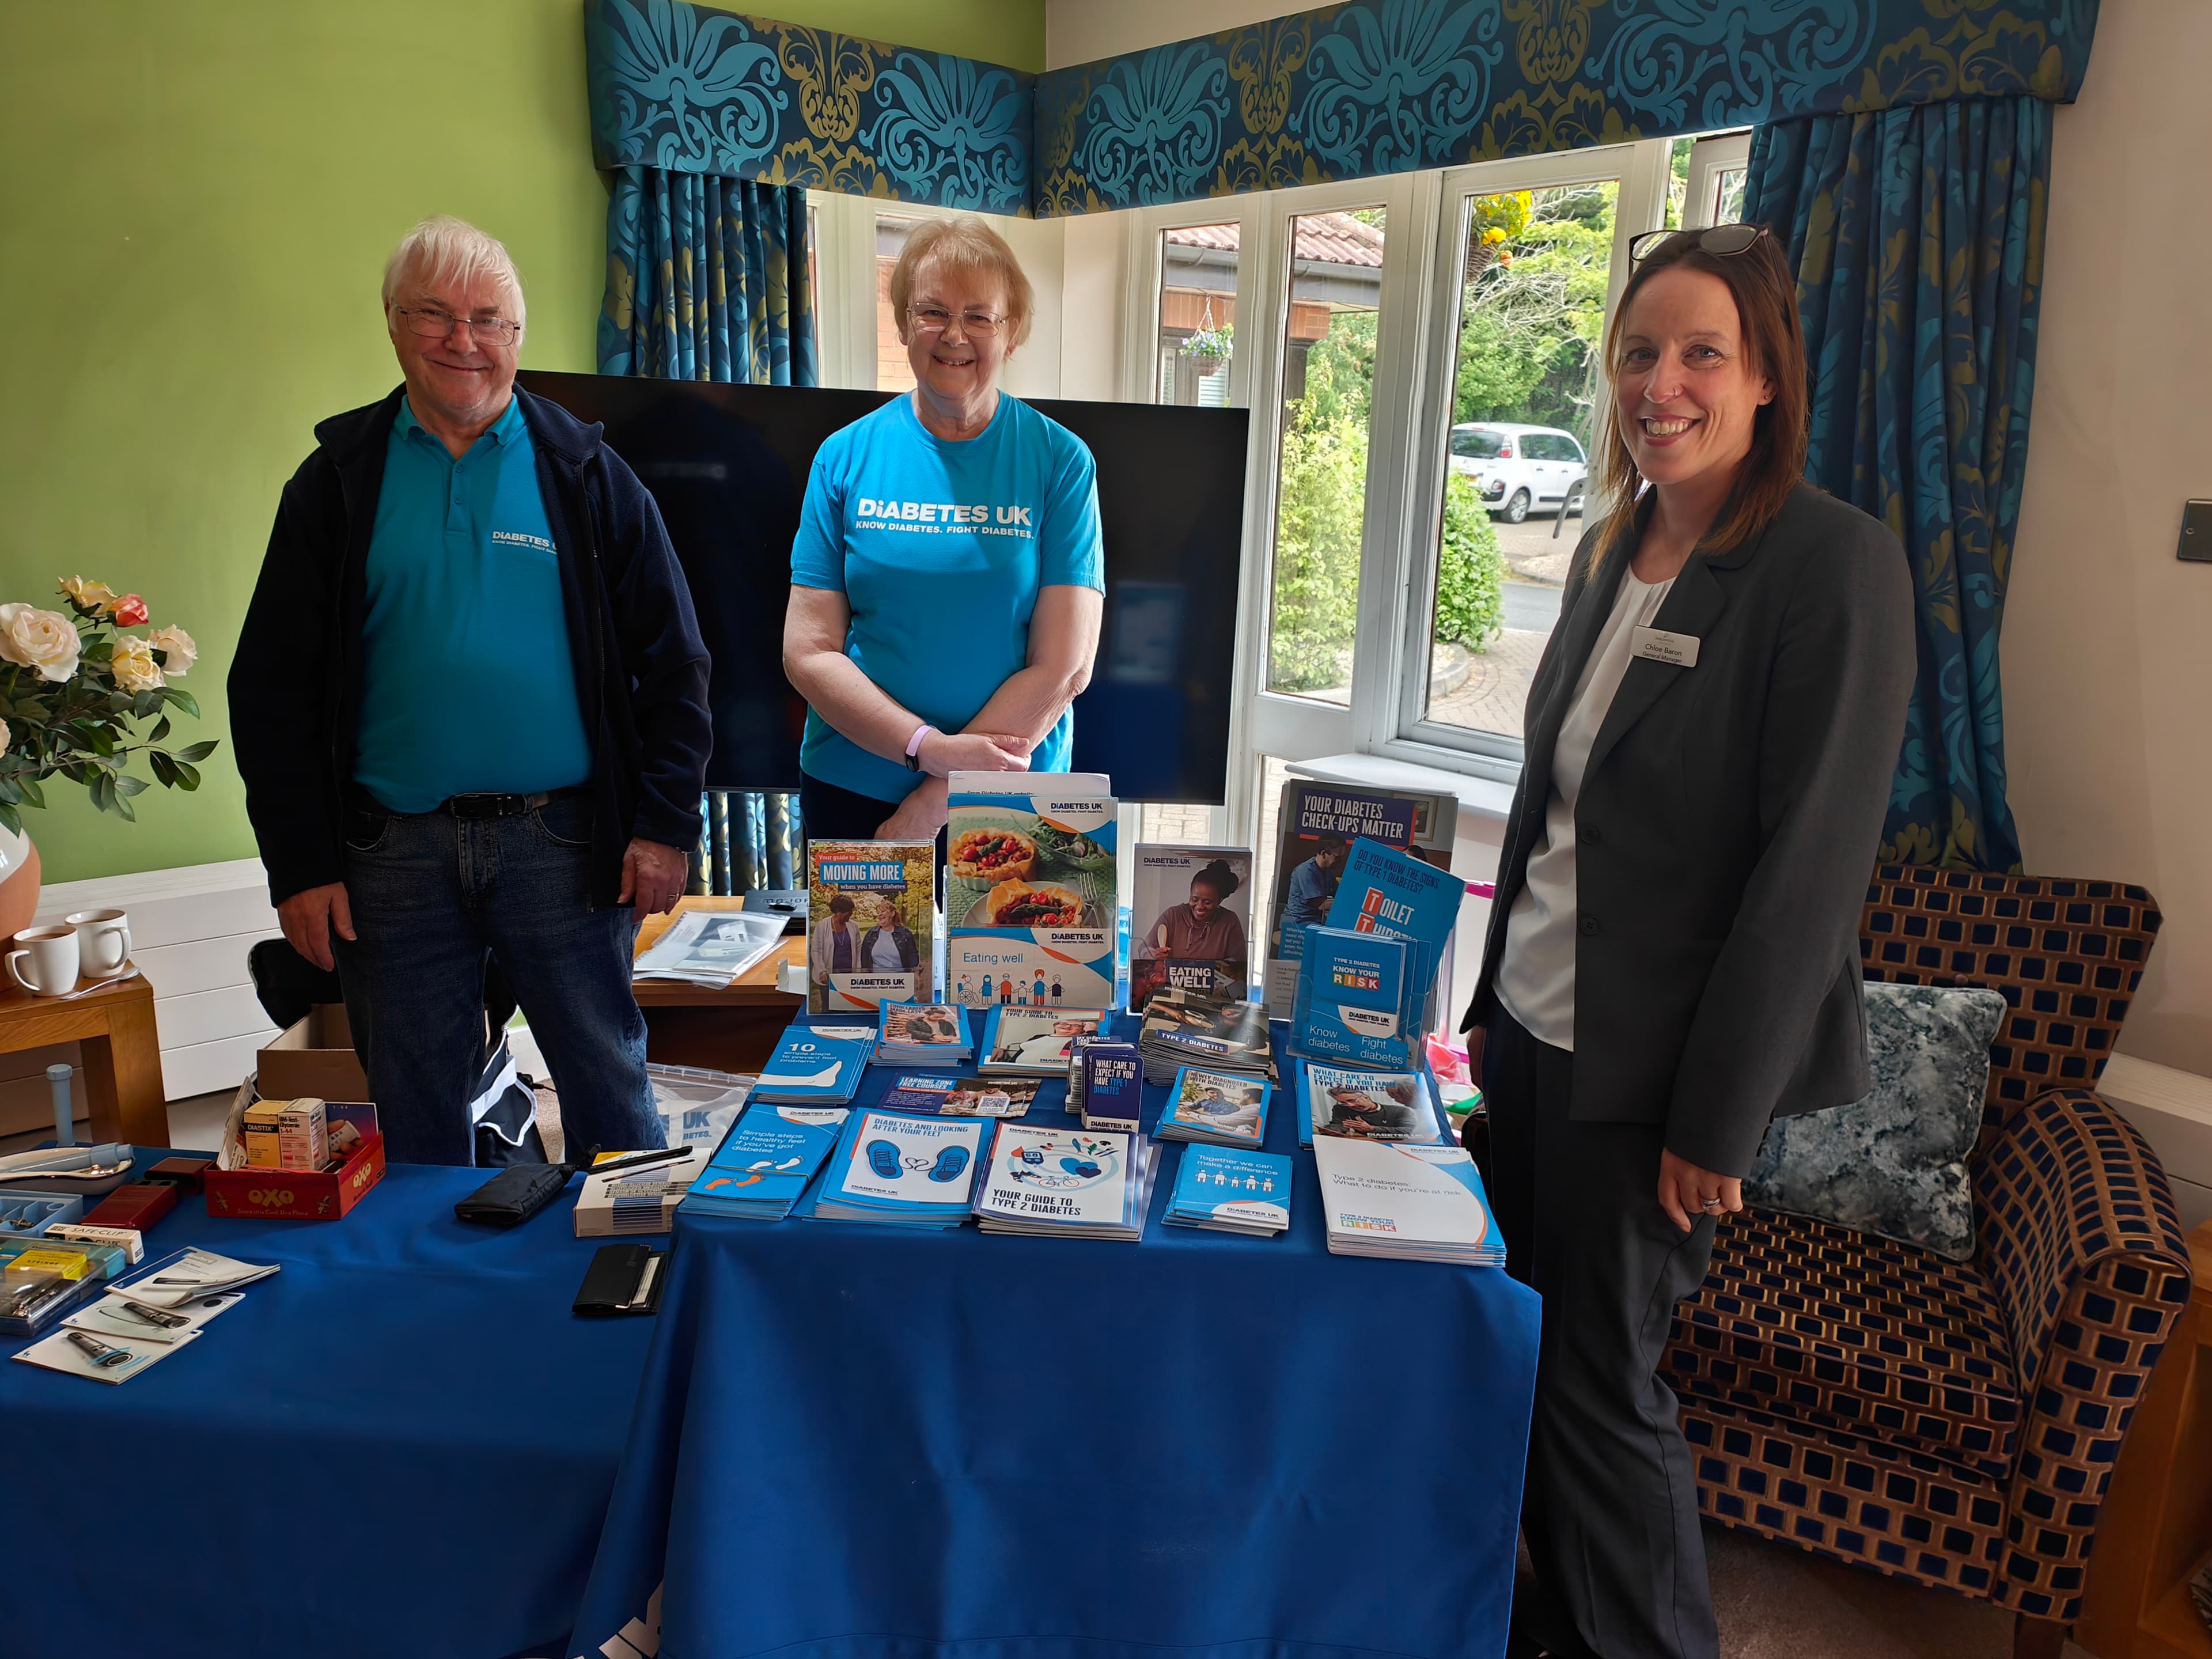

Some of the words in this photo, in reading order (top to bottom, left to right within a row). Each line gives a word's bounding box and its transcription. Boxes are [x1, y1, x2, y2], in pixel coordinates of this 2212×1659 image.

[996, 505, 1032, 526] UK
[855, 520, 886, 529] KNOW
[888, 522, 942, 533] DIABETES.
[982, 527, 1034, 539] DIABETES.
[1645, 643, 1662, 652] Chloe
[1664, 647, 1682, 656] Baron
[1642, 652, 1661, 660] General
[1661, 656, 1682, 664] Manager
[1304, 795, 1332, 813] YOUR
[1334, 799, 1384, 819] DIABETES
[1301, 812, 1359, 833] CHECK-UPS
[1362, 819, 1403, 839] MATTER
[824, 865, 866, 881] MOVING
[870, 865, 900, 881] MORE
[1358, 849, 1369, 862] DO
[1369, 853, 1384, 867] YOU
[1384, 859, 1406, 875] KNOW
[1406, 867, 1420, 881] THE
[1420, 872, 1440, 889] SIGNS
[1354, 860, 1363, 872] OF
[1364, 863, 1382, 879] TYPE
[1382, 870, 1388, 881] 1
[1387, 873, 1424, 895] DIABETES?
[1369, 893, 1415, 926] TOILET
[963, 953, 998, 964] Eating
[1002, 953, 1023, 963] well
[1354, 960, 1380, 968] DIABETES
[1169, 967, 1211, 977] EATING
[1333, 965, 1357, 974] KNOW
[1358, 969, 1380, 978] YOUR
[1169, 976, 1210, 988] WELL
[1334, 974, 1378, 989] RISK
[1309, 1025, 1338, 1038] Know
[789, 1043, 816, 1052] 10
[1161, 1033, 1180, 1041] TYPE
[1189, 1040, 1224, 1051] DIABETES
[1308, 1037, 1350, 1052] diabetes
[1362, 1036, 1387, 1050] Fight
[1360, 1050, 1403, 1065] diabetes
[1096, 1059, 1112, 1069] WHAT
[1113, 1060, 1127, 1070] CARE
[1129, 1062, 1136, 1070] TO
[1095, 1068, 1115, 1077] EXPECT
[1116, 1070, 1122, 1078] IF
[1123, 1070, 1134, 1079] YOU
[1313, 1068, 1337, 1077] WHAT
[1313, 1073, 1343, 1083] EXPECT
[1094, 1077, 1108, 1085] HAVE
[1109, 1078, 1123, 1086] TYPE
[1124, 1079, 1127, 1088] 1
[1208, 1080, 1236, 1090] DIABETES
[1213, 1076, 1247, 1087] DIAGNOSED
[1314, 1080, 1334, 1088] TYPE
[1094, 1085, 1119, 1095] DIABETES
[683, 1111, 711, 1129] UK
[874, 1118, 913, 1128] DIABETES
[683, 1131, 711, 1140] BETES.
[743, 1130, 775, 1138] Simple
[872, 1124, 897, 1132] AFTER
[900, 1127, 921, 1135] YOUR
[1198, 1154, 1238, 1164] Together
[353, 1162, 372, 1188] OXO
[1233, 1165, 1278, 1175] difference
[1332, 1173, 1355, 1181] Type
[248, 1188, 295, 1207] OXO
[993, 1188, 1021, 1200] YOUR
[1025, 1194, 1056, 1205] GUIDE
[1060, 1198, 1073, 1206] TO
[991, 1197, 1017, 1209] TYPE
[1020, 1202, 1028, 1210] 2
[1031, 1203, 1081, 1215] DIABETES
[1343, 1220, 1395, 1232] RISK
